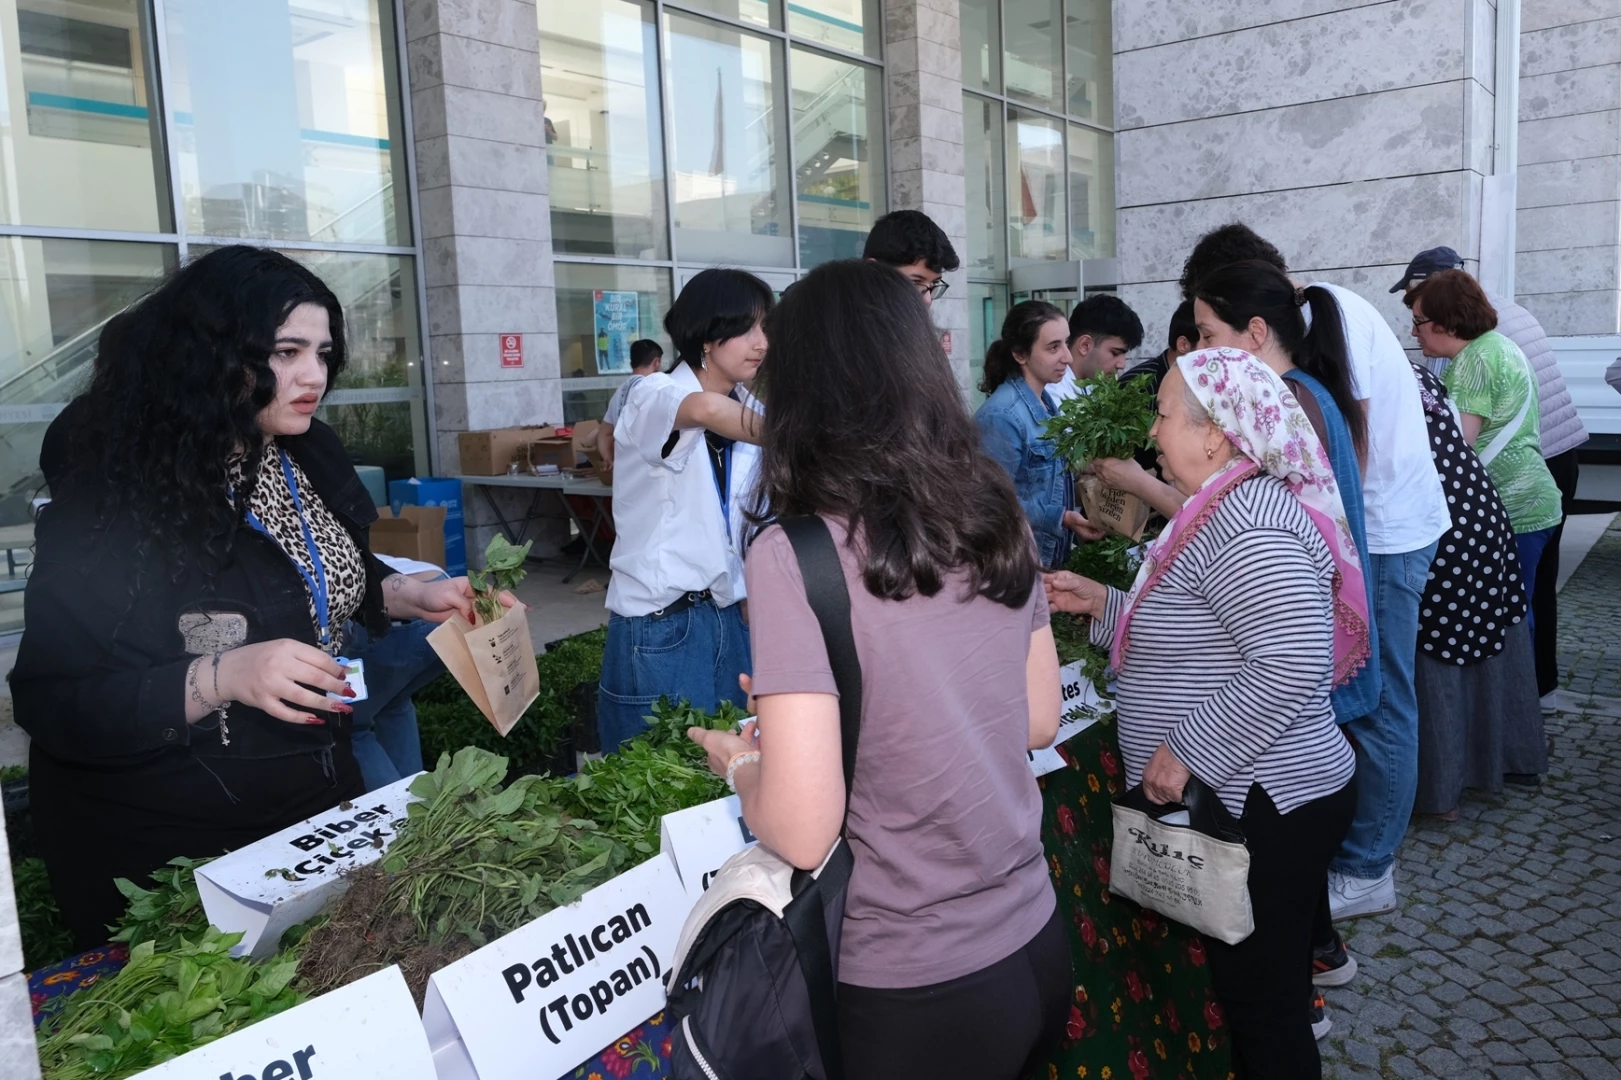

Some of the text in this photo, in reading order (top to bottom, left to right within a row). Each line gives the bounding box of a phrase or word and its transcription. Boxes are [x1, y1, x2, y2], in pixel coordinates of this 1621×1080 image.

[289, 804, 391, 852] Biber
[502, 903, 652, 1004] Patlıcan
[539, 945, 661, 1045] (Topan)
